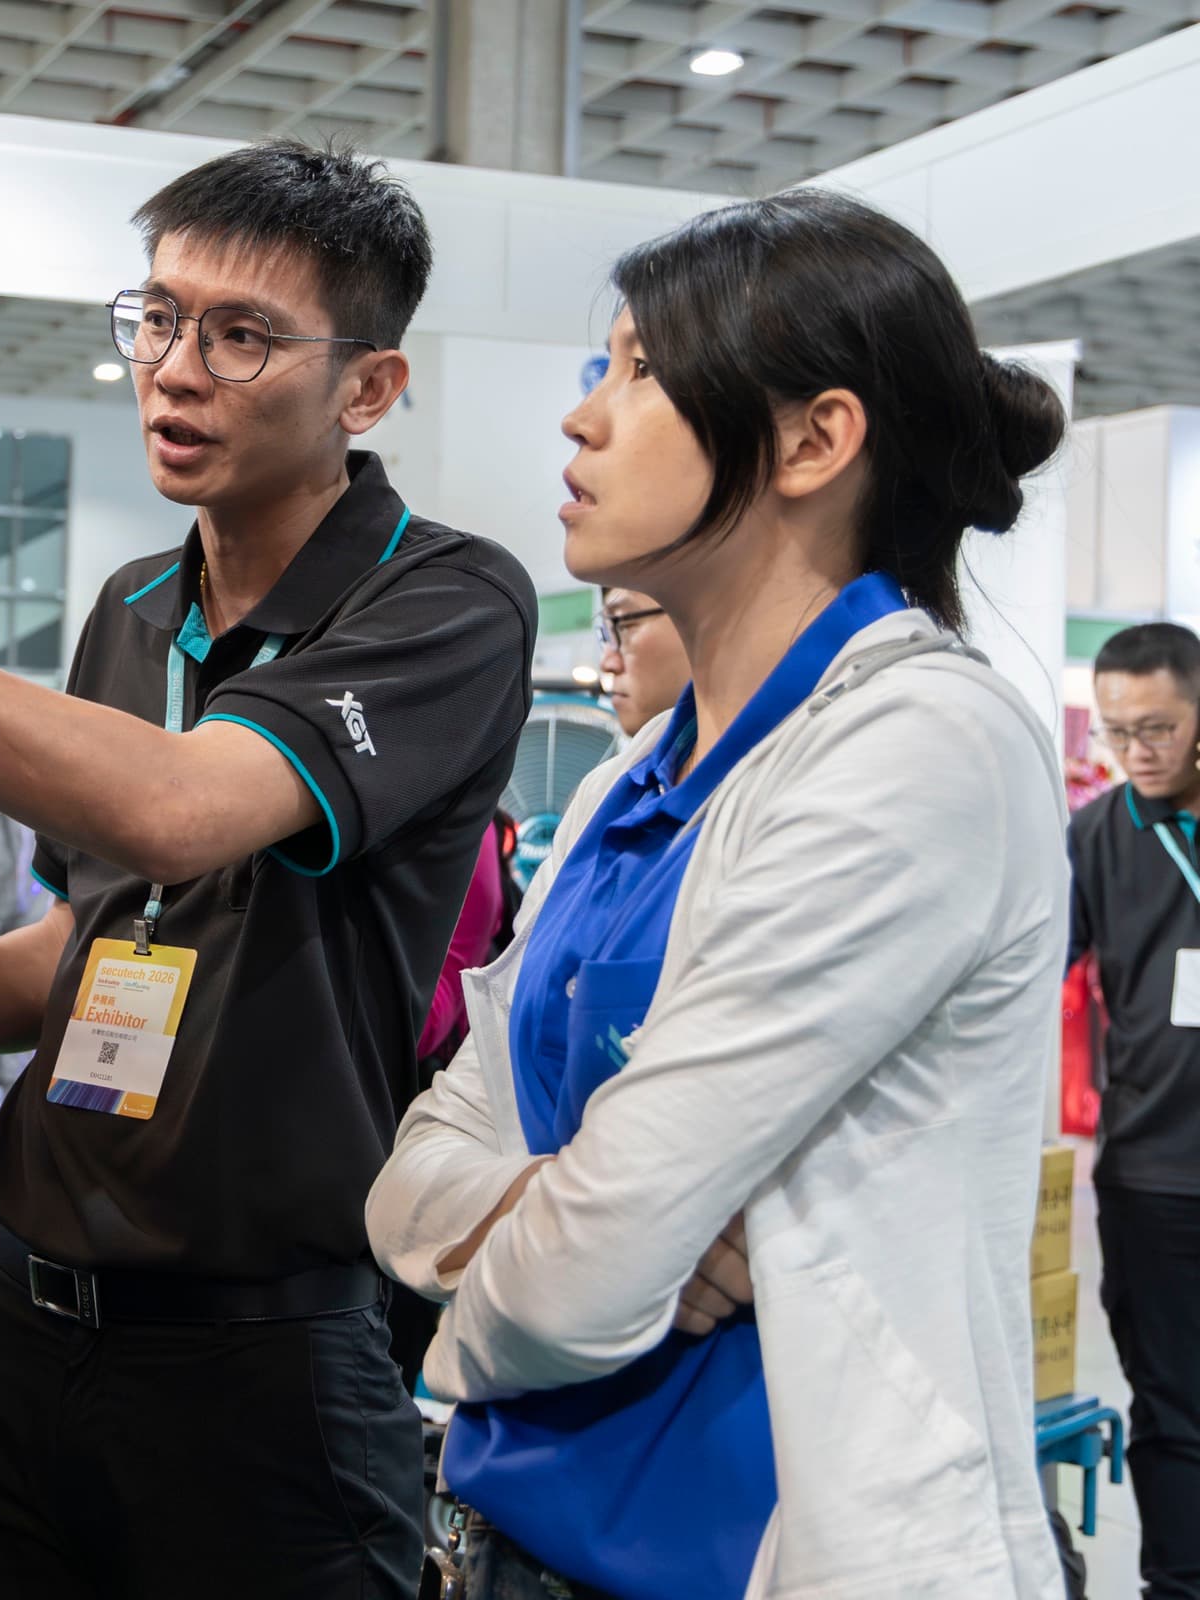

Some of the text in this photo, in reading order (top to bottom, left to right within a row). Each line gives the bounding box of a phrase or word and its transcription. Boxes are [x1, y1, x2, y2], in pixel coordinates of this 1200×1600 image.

[325, 690, 377, 756] XGT
[101, 966, 176, 985] secutech 2026
[86, 1005, 149, 1030] Exhibitor
